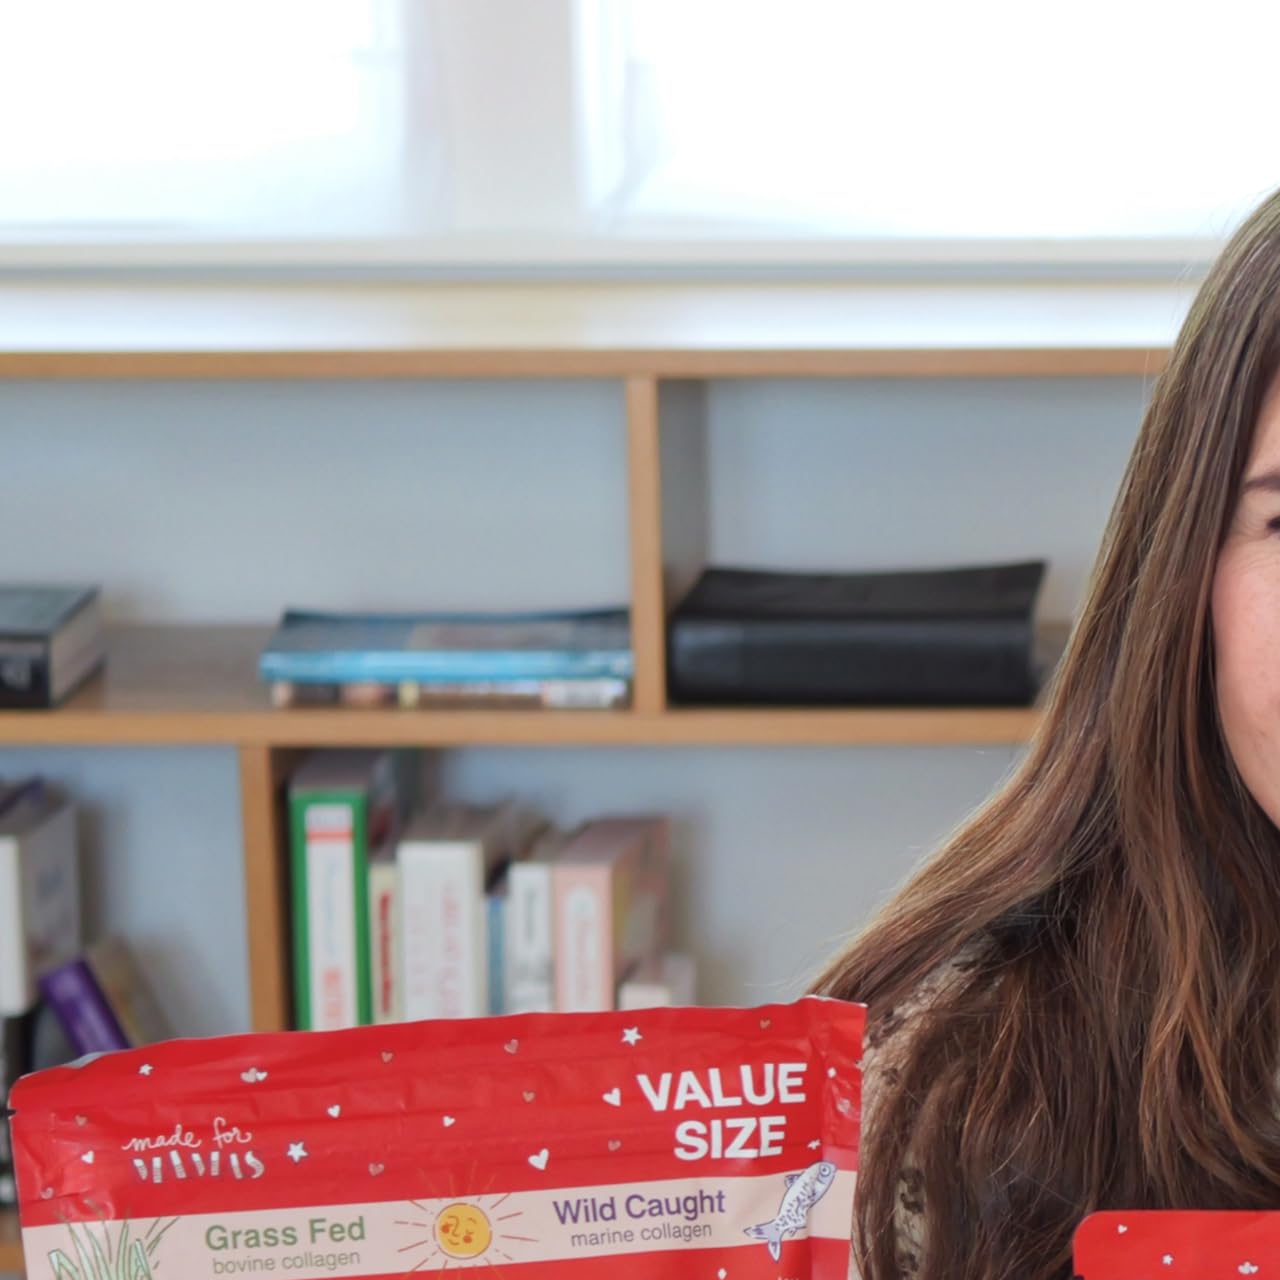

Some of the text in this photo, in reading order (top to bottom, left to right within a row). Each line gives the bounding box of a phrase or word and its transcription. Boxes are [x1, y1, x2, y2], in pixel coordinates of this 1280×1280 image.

[637, 1063, 807, 1111] VALUE
[122, 1117, 252, 1151] made for
[673, 1116, 787, 1160] SIZE
[552, 1189, 726, 1225] Wild Caught
[205, 1216, 366, 1251] Grass Fed
[571, 1222, 712, 1248] marine collagen
[213, 1251, 361, 1274] bovine collagen
